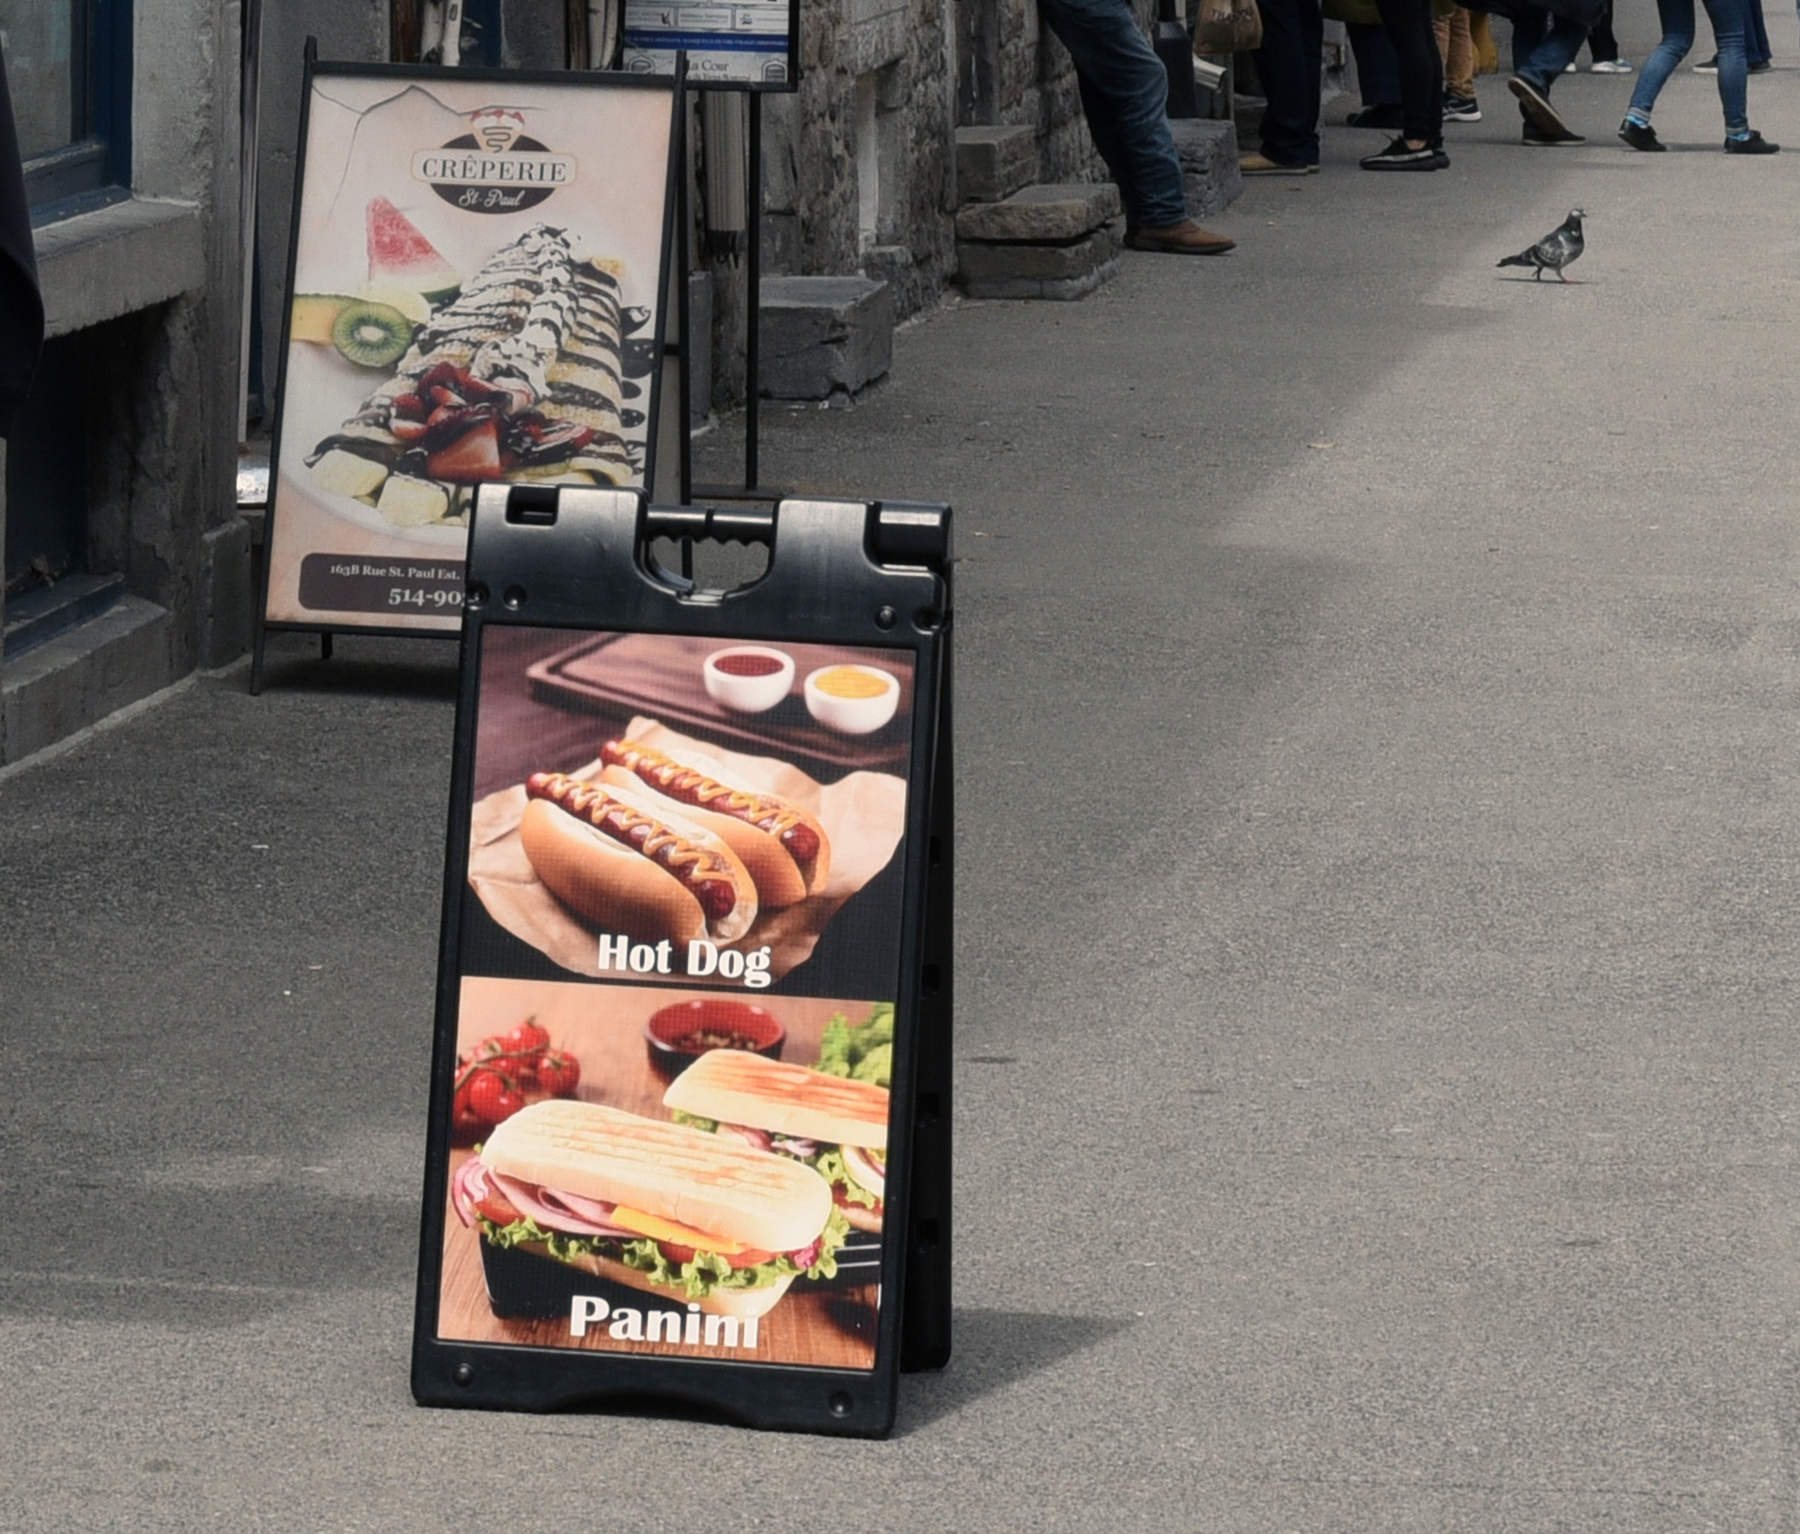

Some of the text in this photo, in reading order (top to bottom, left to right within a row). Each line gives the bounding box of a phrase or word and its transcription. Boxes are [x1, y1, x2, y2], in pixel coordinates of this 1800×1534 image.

[422, 153, 568, 184] CRÊPERIE
[458, 187, 526, 211] St-Paul
[330, 564, 461, 581] 163B Rue St. Paul Est.
[387, 587, 465, 608] 514-90
[598, 933, 772, 988] Hot Dog
[570, 1294, 761, 1350] Panini
